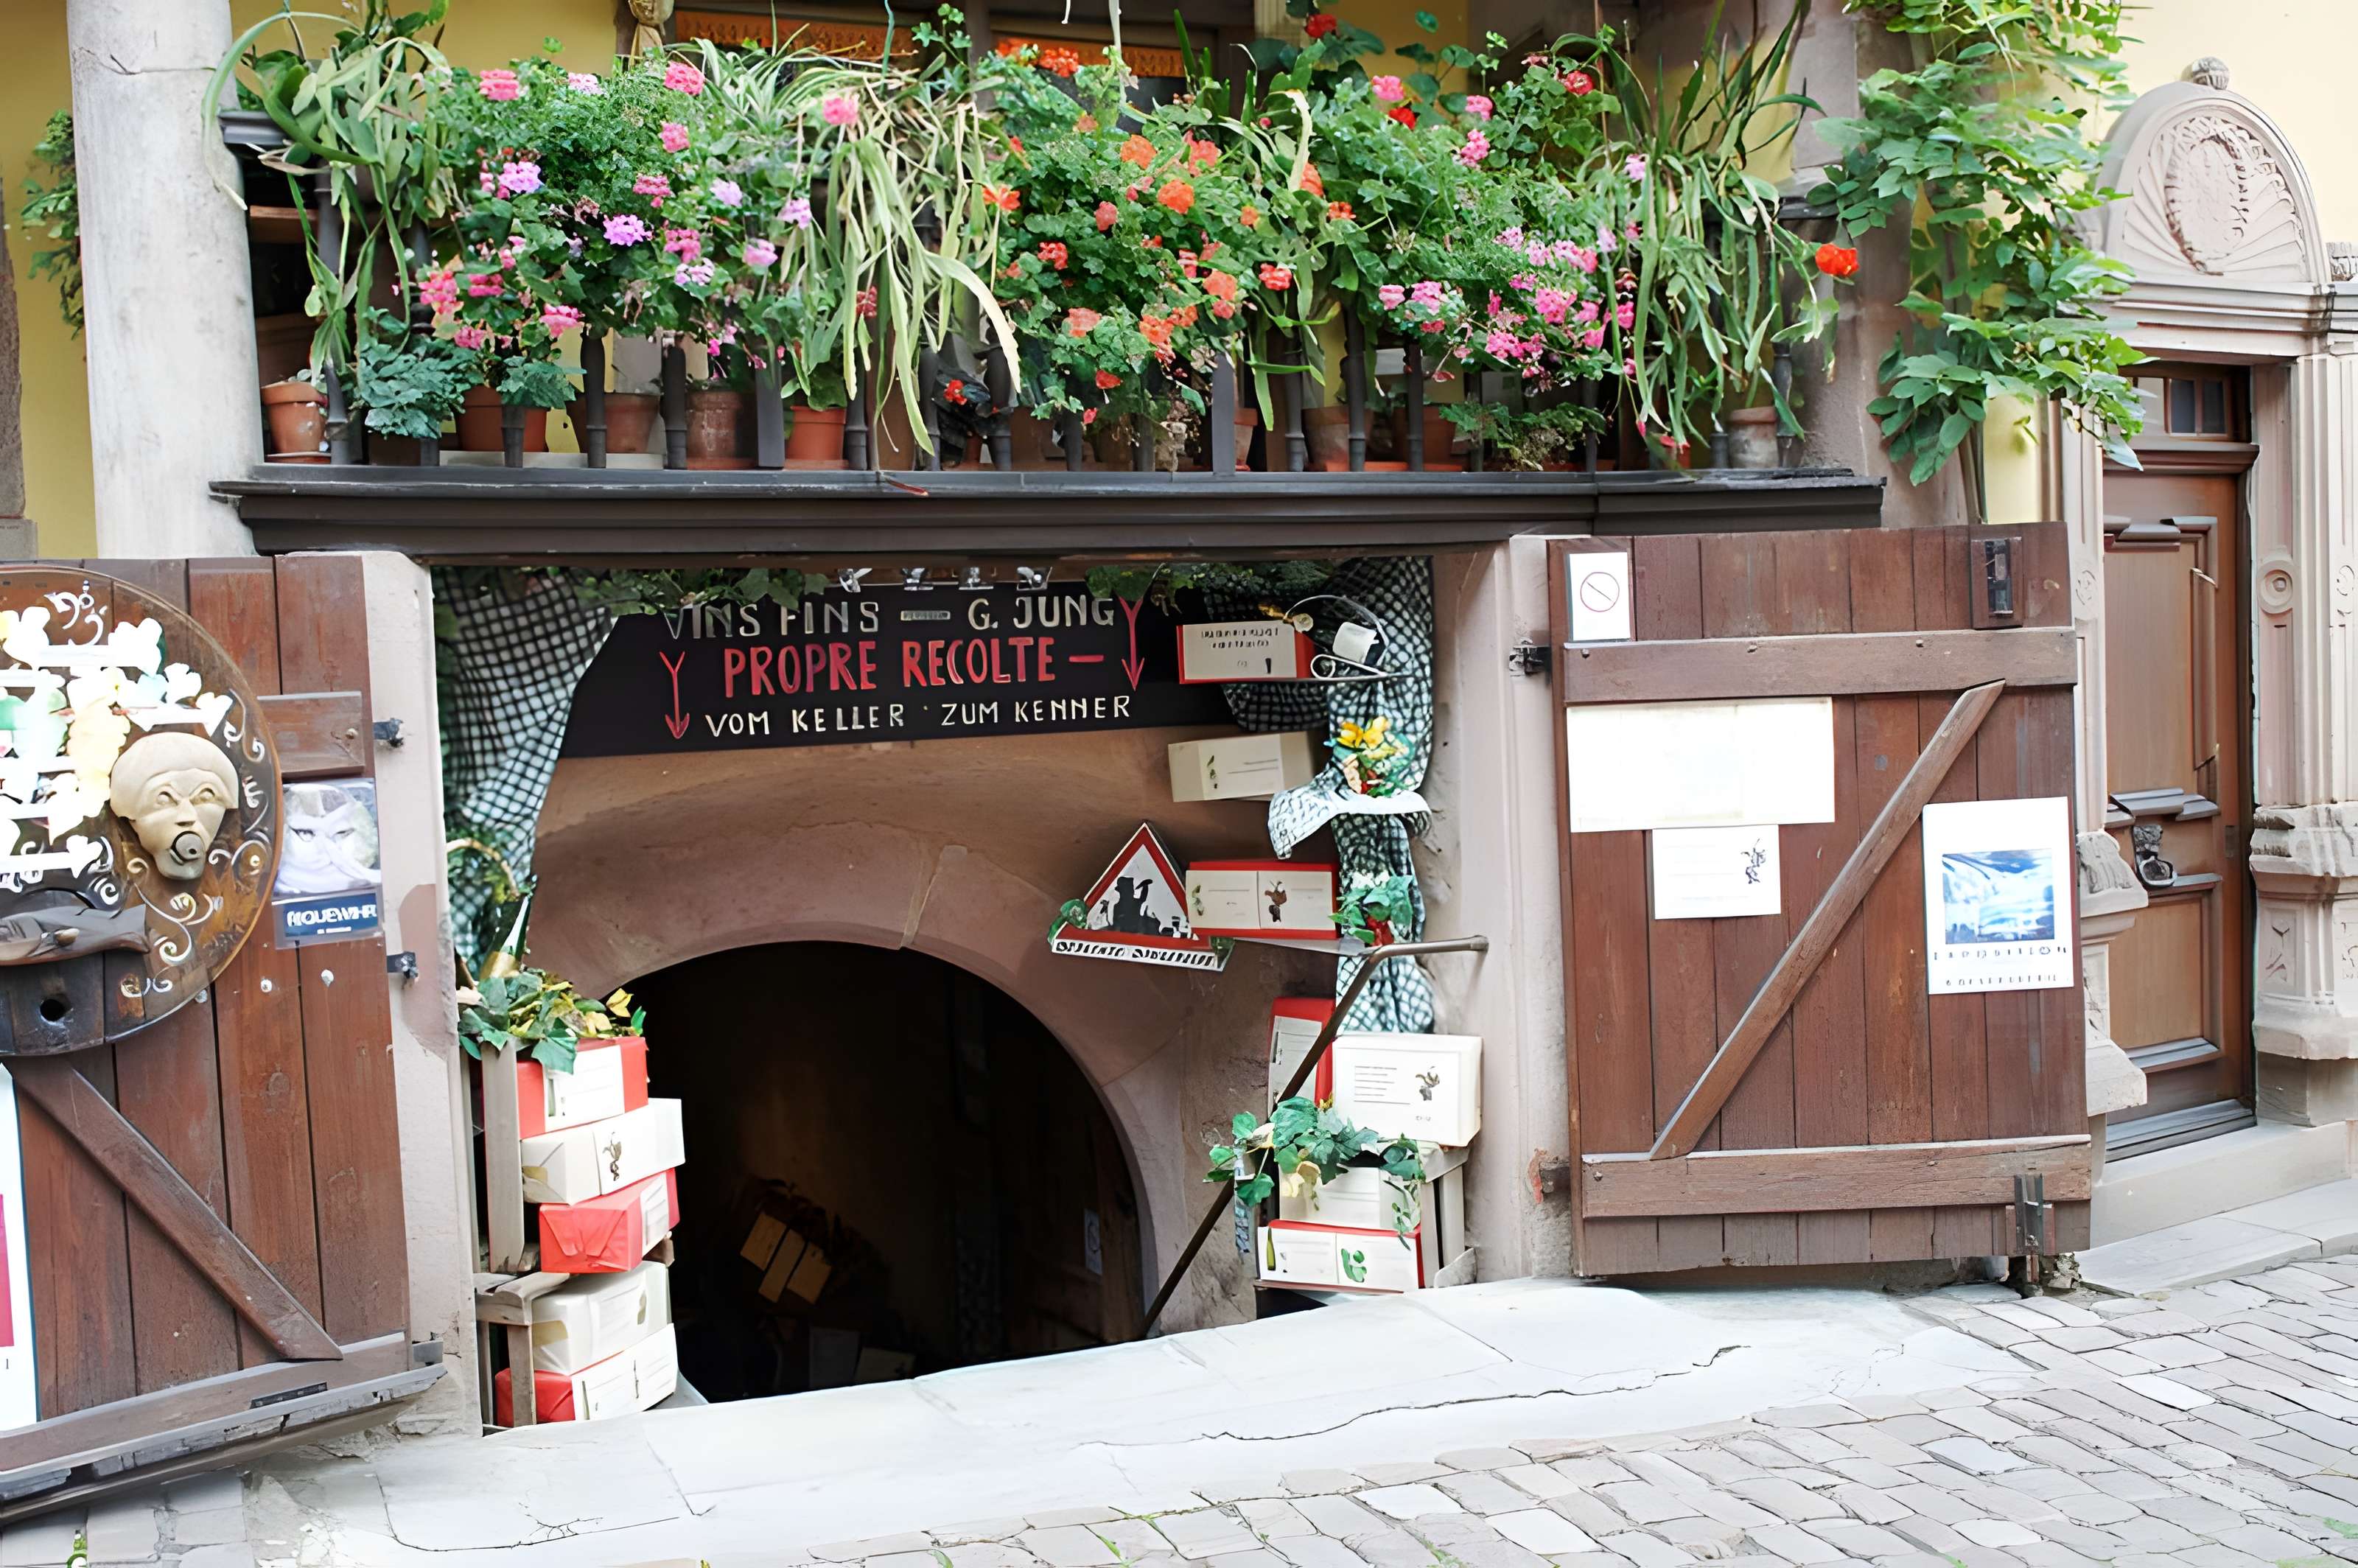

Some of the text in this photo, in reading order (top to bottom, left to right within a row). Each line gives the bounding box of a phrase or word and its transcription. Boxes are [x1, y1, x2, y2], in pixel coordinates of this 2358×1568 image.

[664, 595, 1114, 640] VINS FINS G. JUNG
[724, 636, 1056, 698] PROPRE RECOLTE
[704, 696, 1130, 737] VOM KELLER ZUM KENNER
